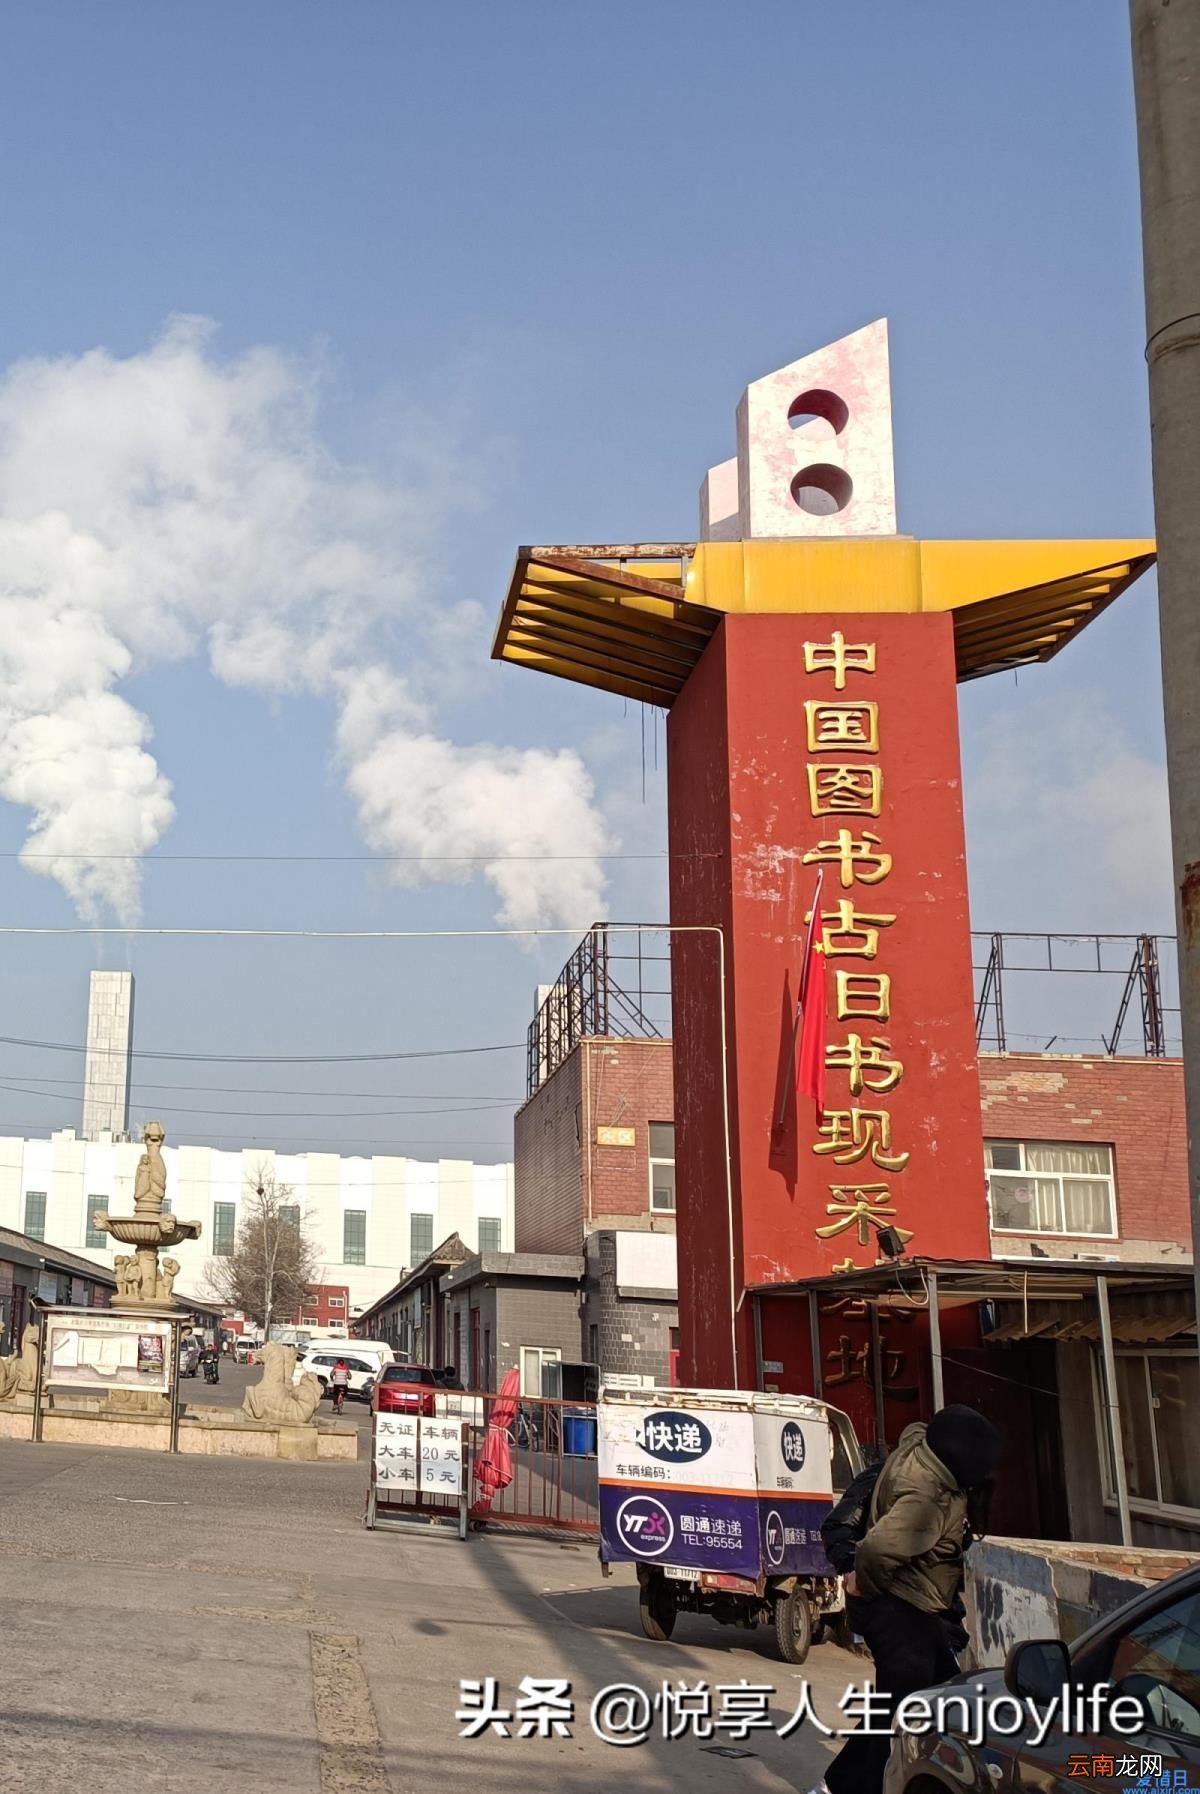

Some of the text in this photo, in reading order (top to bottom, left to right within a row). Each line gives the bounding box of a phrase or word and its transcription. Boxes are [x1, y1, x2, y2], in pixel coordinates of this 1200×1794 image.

[422, 1425, 459, 1441] 车辆
[646, 1420, 703, 1454] 快递
[378, 1445, 415, 1460] 大车
[379, 1467, 415, 1481] 小车
[680, 1514, 743, 1537] 圆通速递
[681, 1533, 743, 1550] TEL:95554
